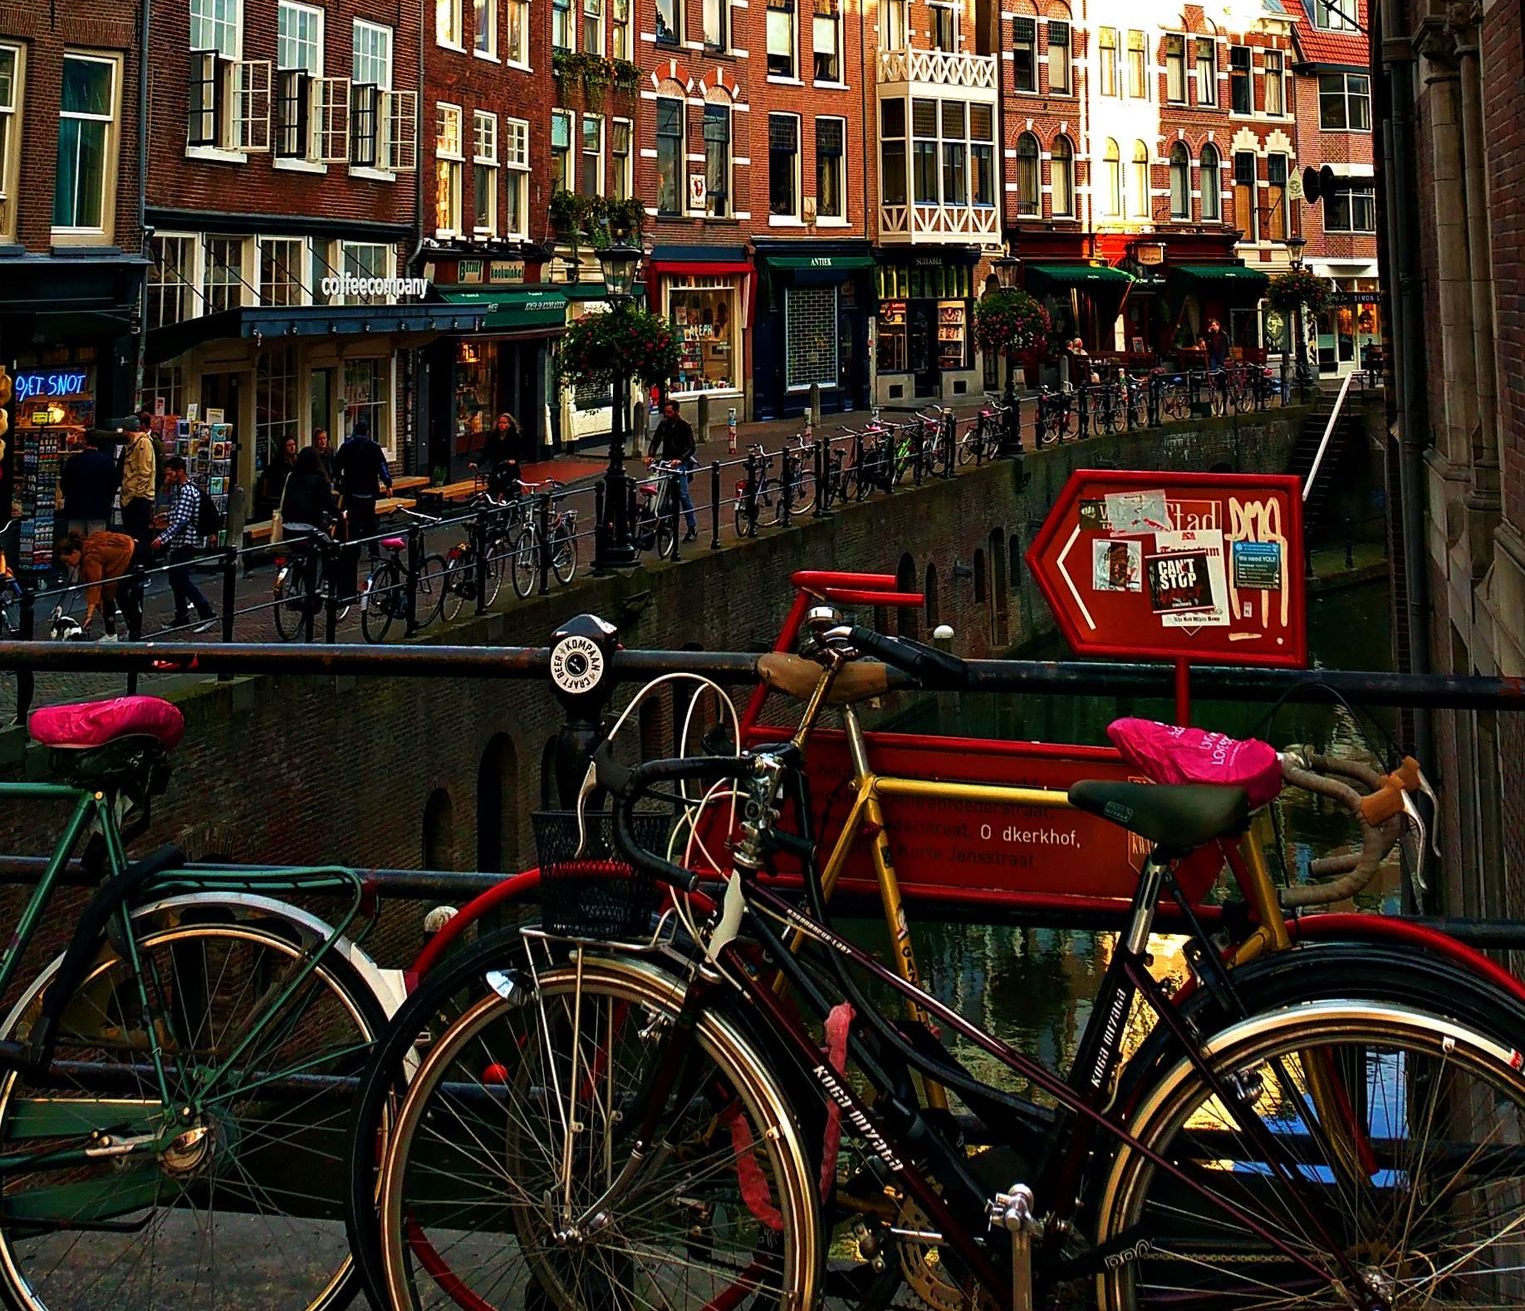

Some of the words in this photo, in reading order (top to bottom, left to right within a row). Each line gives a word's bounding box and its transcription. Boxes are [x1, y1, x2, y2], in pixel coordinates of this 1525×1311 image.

[321, 274, 428, 299] coffeecompany
[48, 374, 86, 396] SNOT
[1158, 558, 1195, 576] CAN'T
[1160, 573, 1197, 590] STOP
[564, 639, 601, 671] KOMPAAN
[554, 655, 565, 679] BEER
[563, 677, 591, 690] CRAFT
